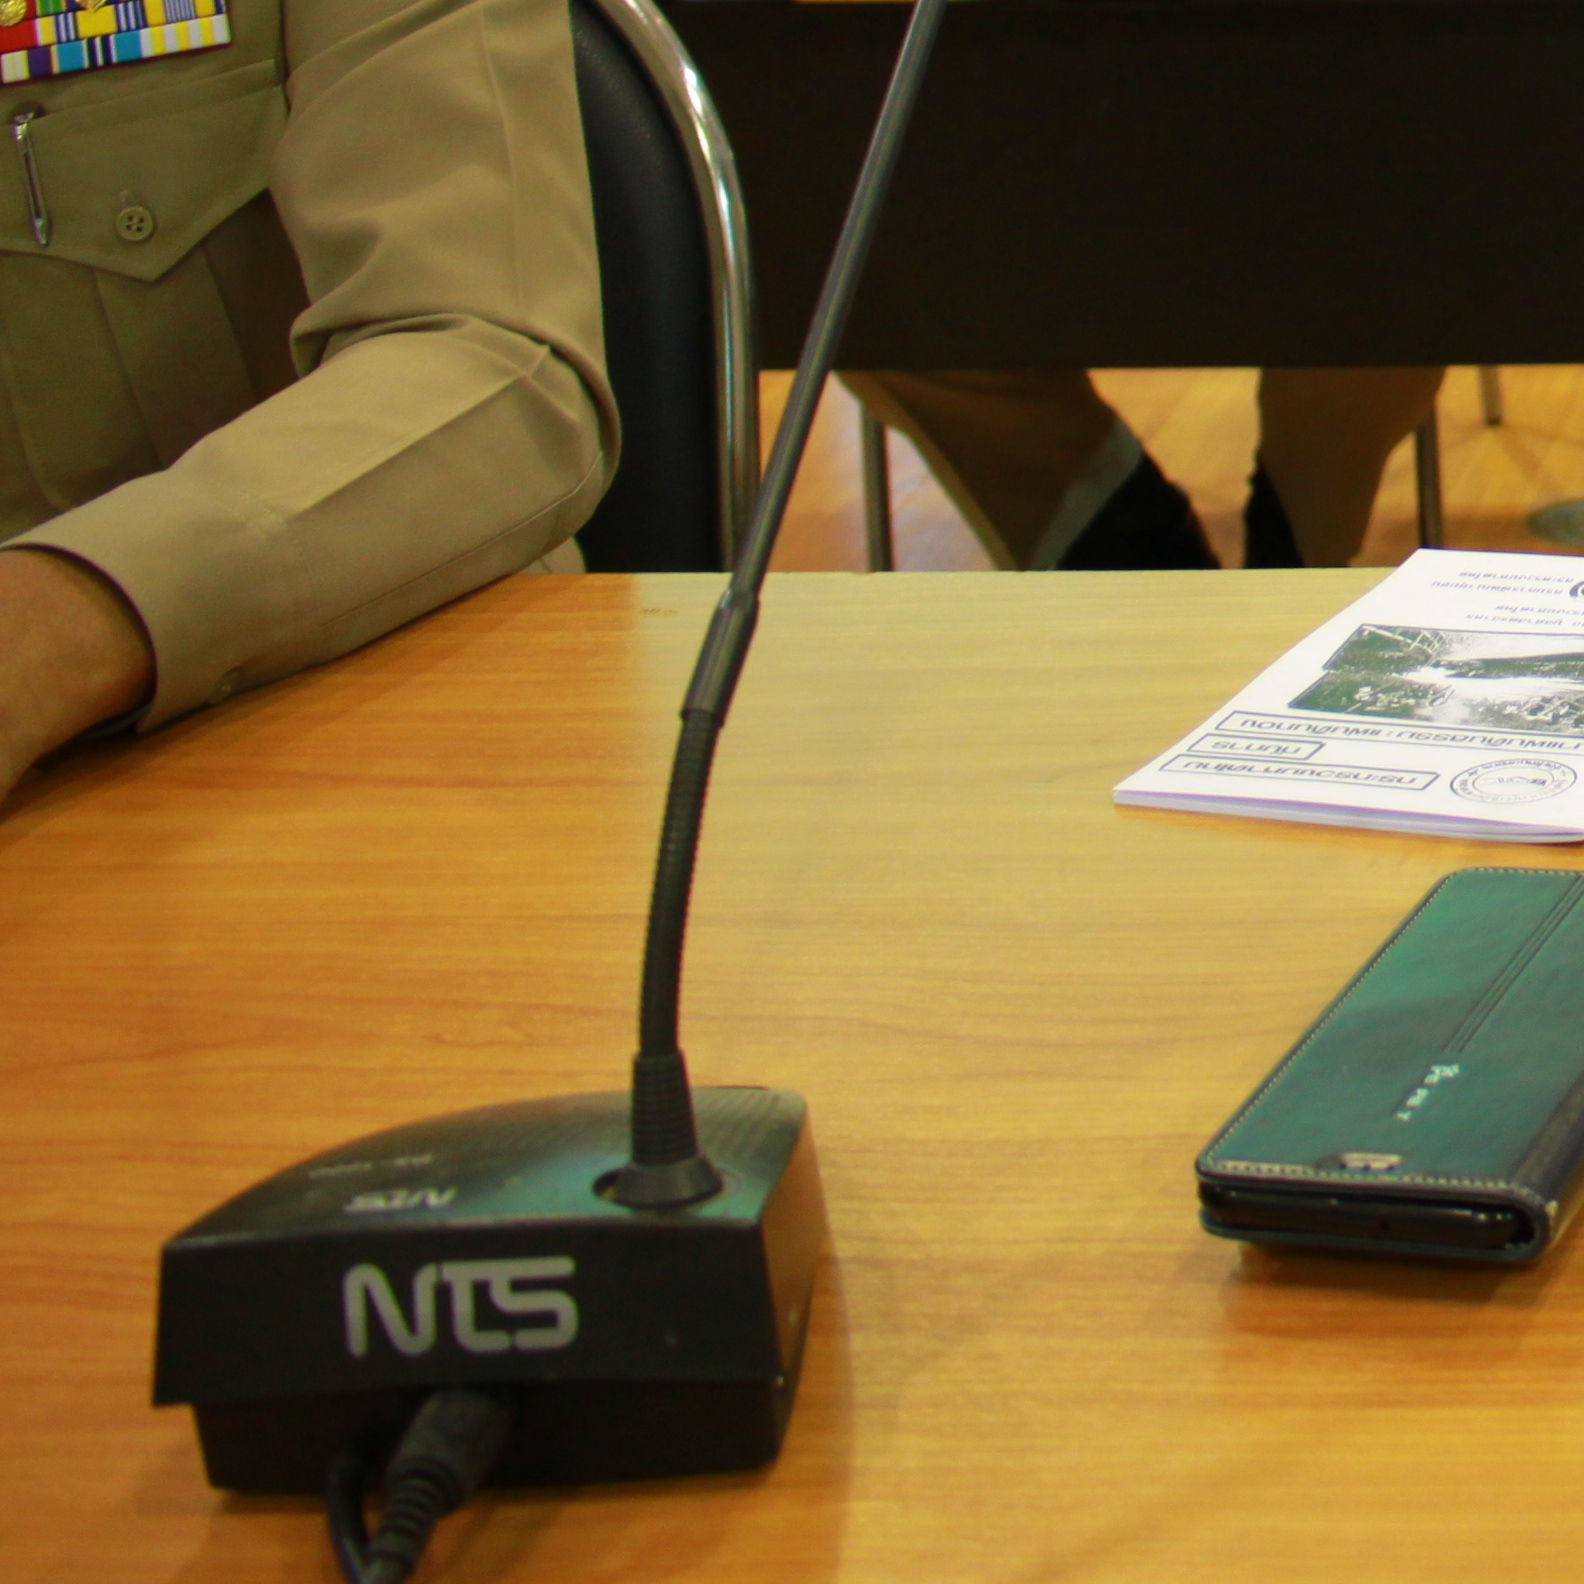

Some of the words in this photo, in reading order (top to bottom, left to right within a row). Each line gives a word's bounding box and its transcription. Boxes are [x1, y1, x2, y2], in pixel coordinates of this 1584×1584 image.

[1236, 717, 1383, 737] แผ่นดินทอง
[1208, 739, 1302, 756] กับการ
[1180, 758, 1419, 786] กระทรวงมหาดไทย
[341, 1254, 581, 1360] NTS
